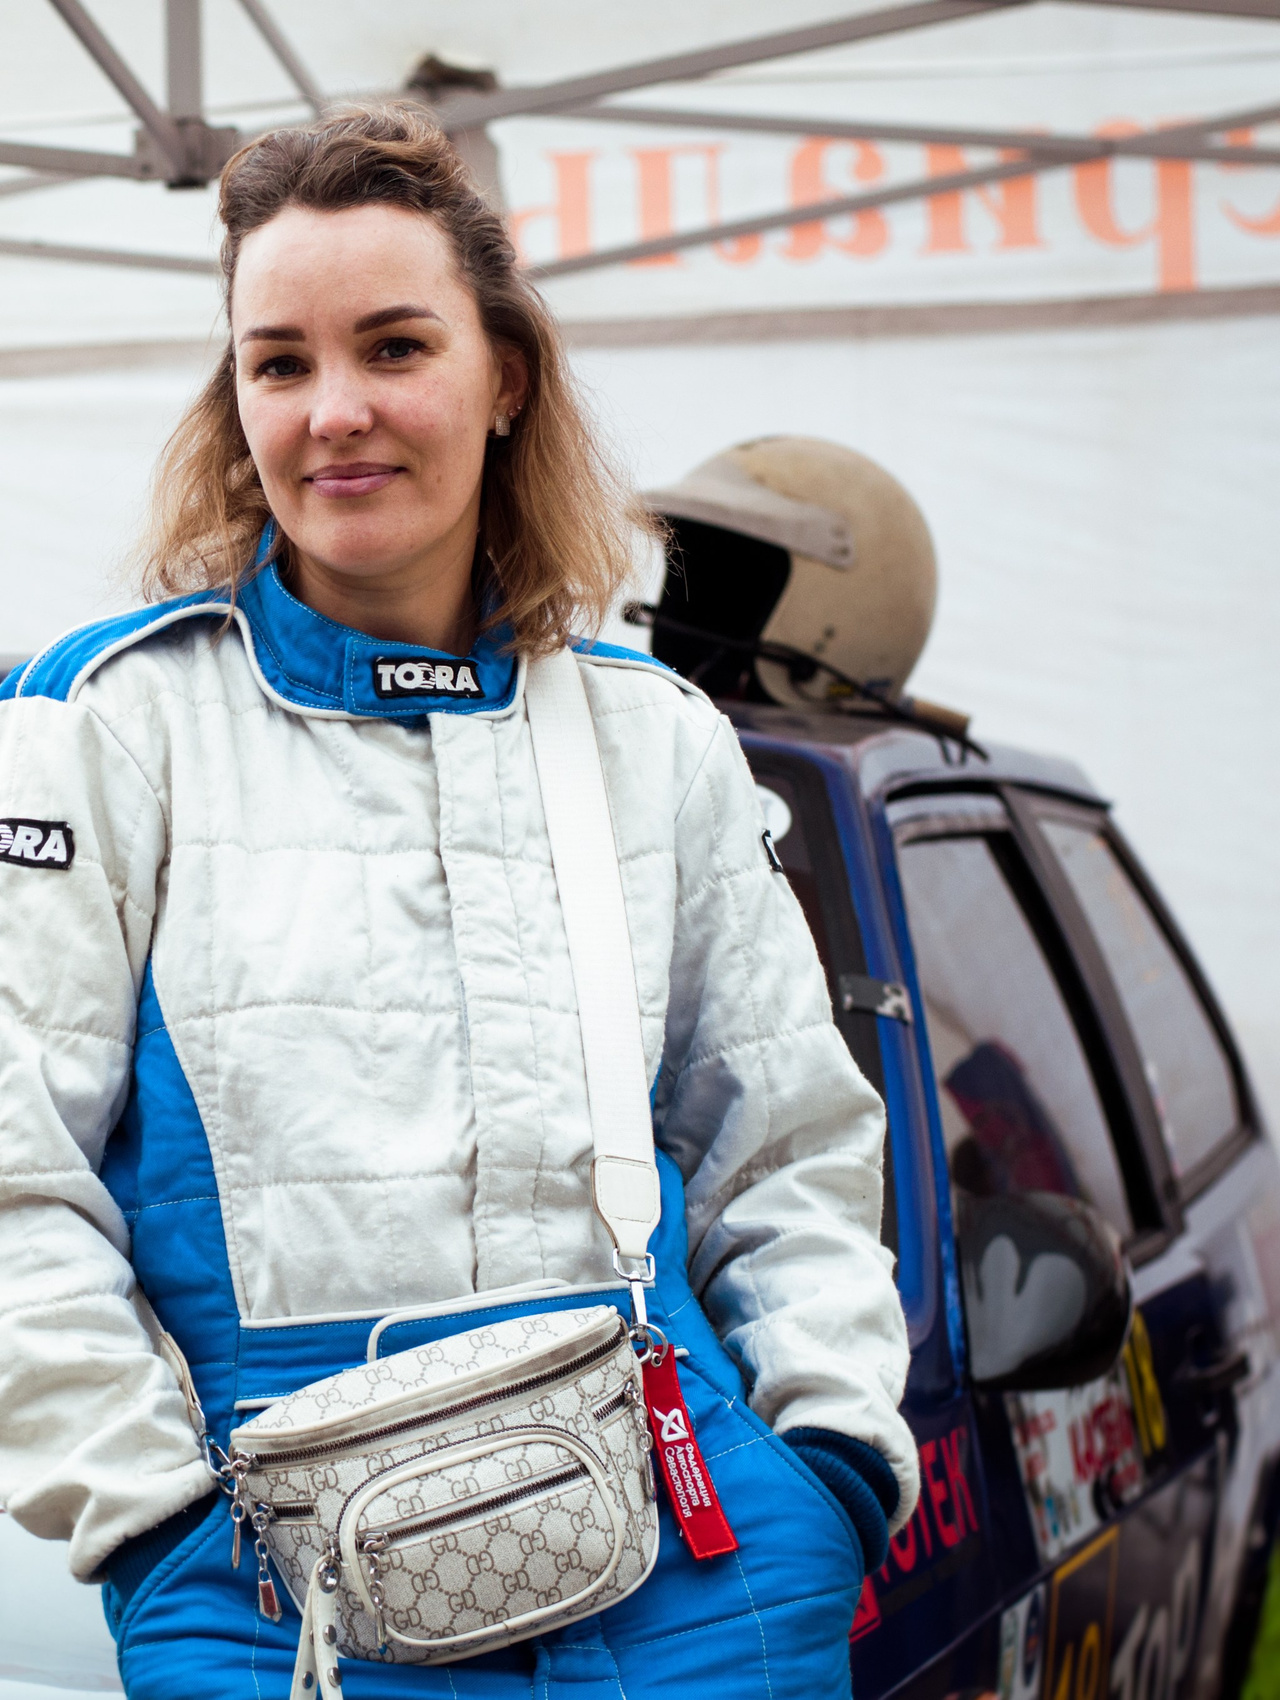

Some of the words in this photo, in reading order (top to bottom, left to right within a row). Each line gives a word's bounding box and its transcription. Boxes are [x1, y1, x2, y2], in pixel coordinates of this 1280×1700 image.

[664, 1446, 693, 1518] Севастополя
[674, 1445, 700, 1506] Автоспорта
[684, 1442, 712, 1507] Федерация
[878, 1426, 980, 1585] OTEK
